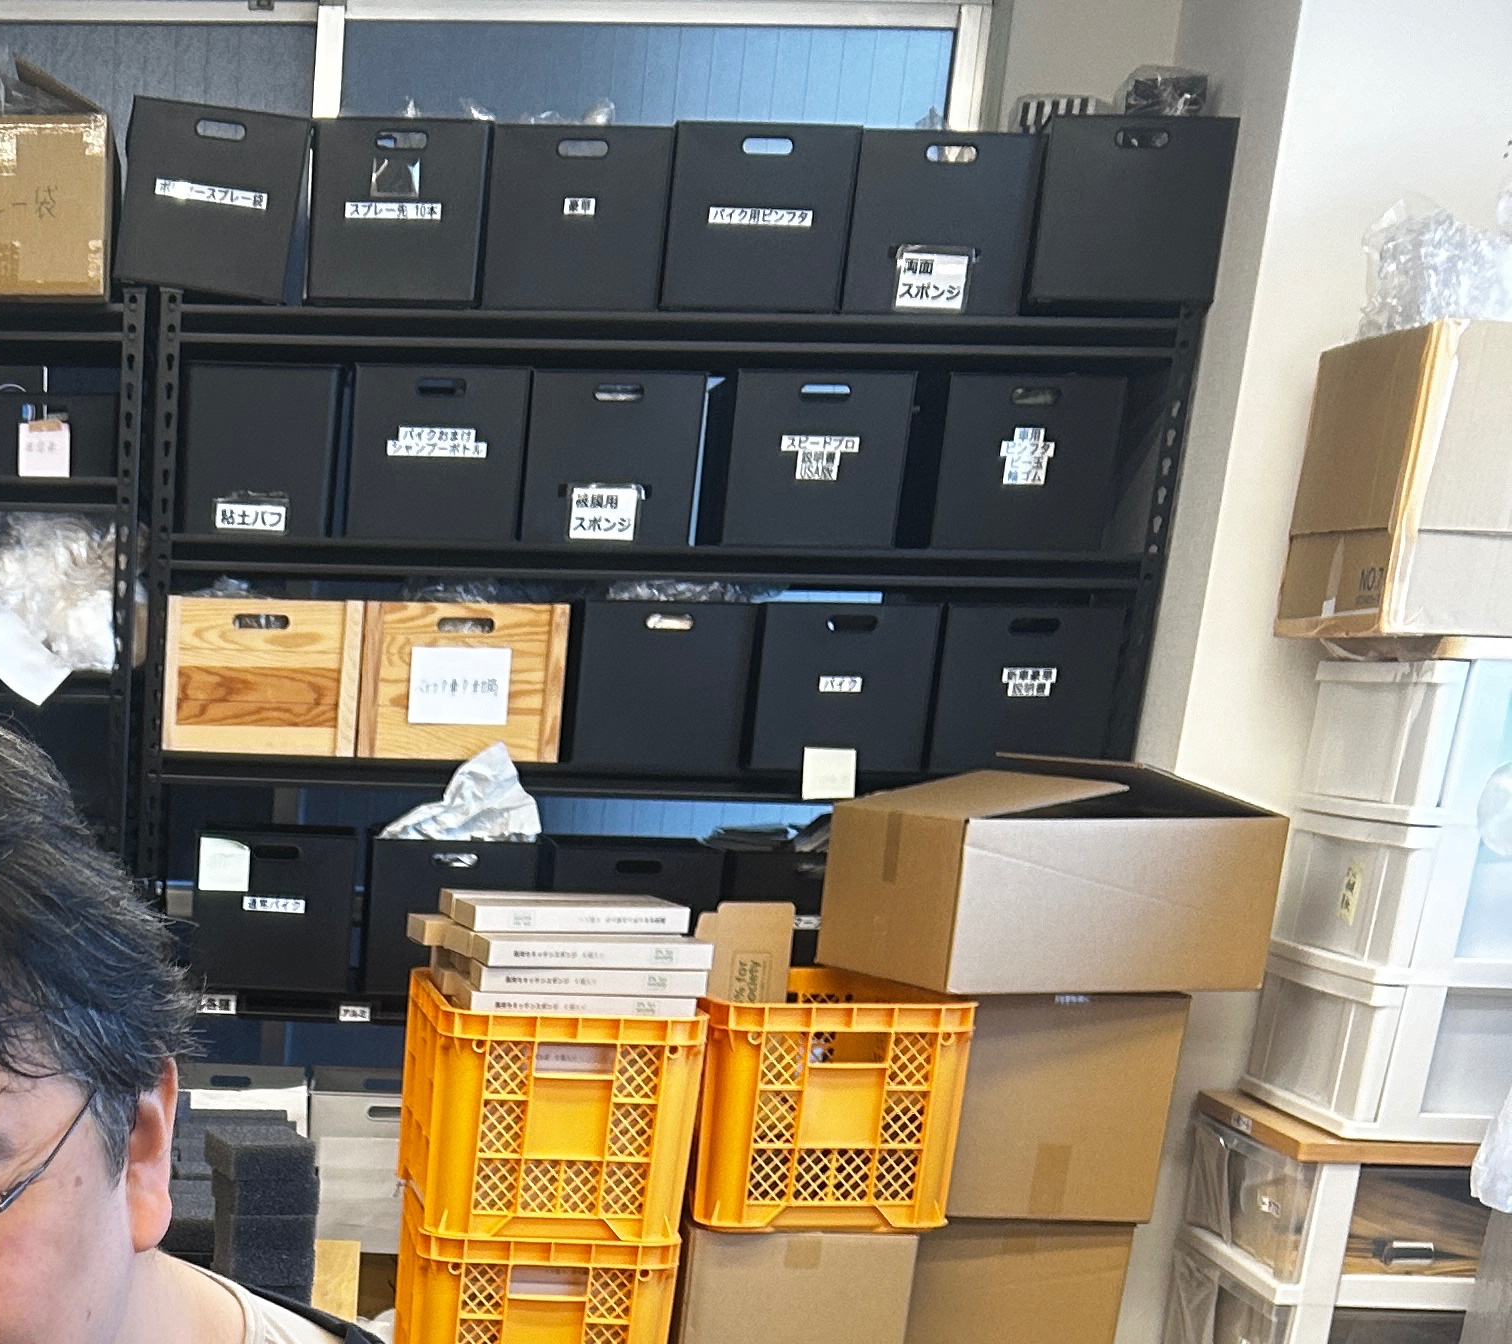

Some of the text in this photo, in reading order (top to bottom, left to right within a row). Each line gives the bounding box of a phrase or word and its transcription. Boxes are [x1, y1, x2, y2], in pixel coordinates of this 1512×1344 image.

[904, 257, 935, 275] 両面
[899, 282, 962, 301] スポンジ
[221, 508, 282, 528] 粘土バフ
[573, 516, 632, 532] スポンジ
[747, 960, 762, 1003] ociety
